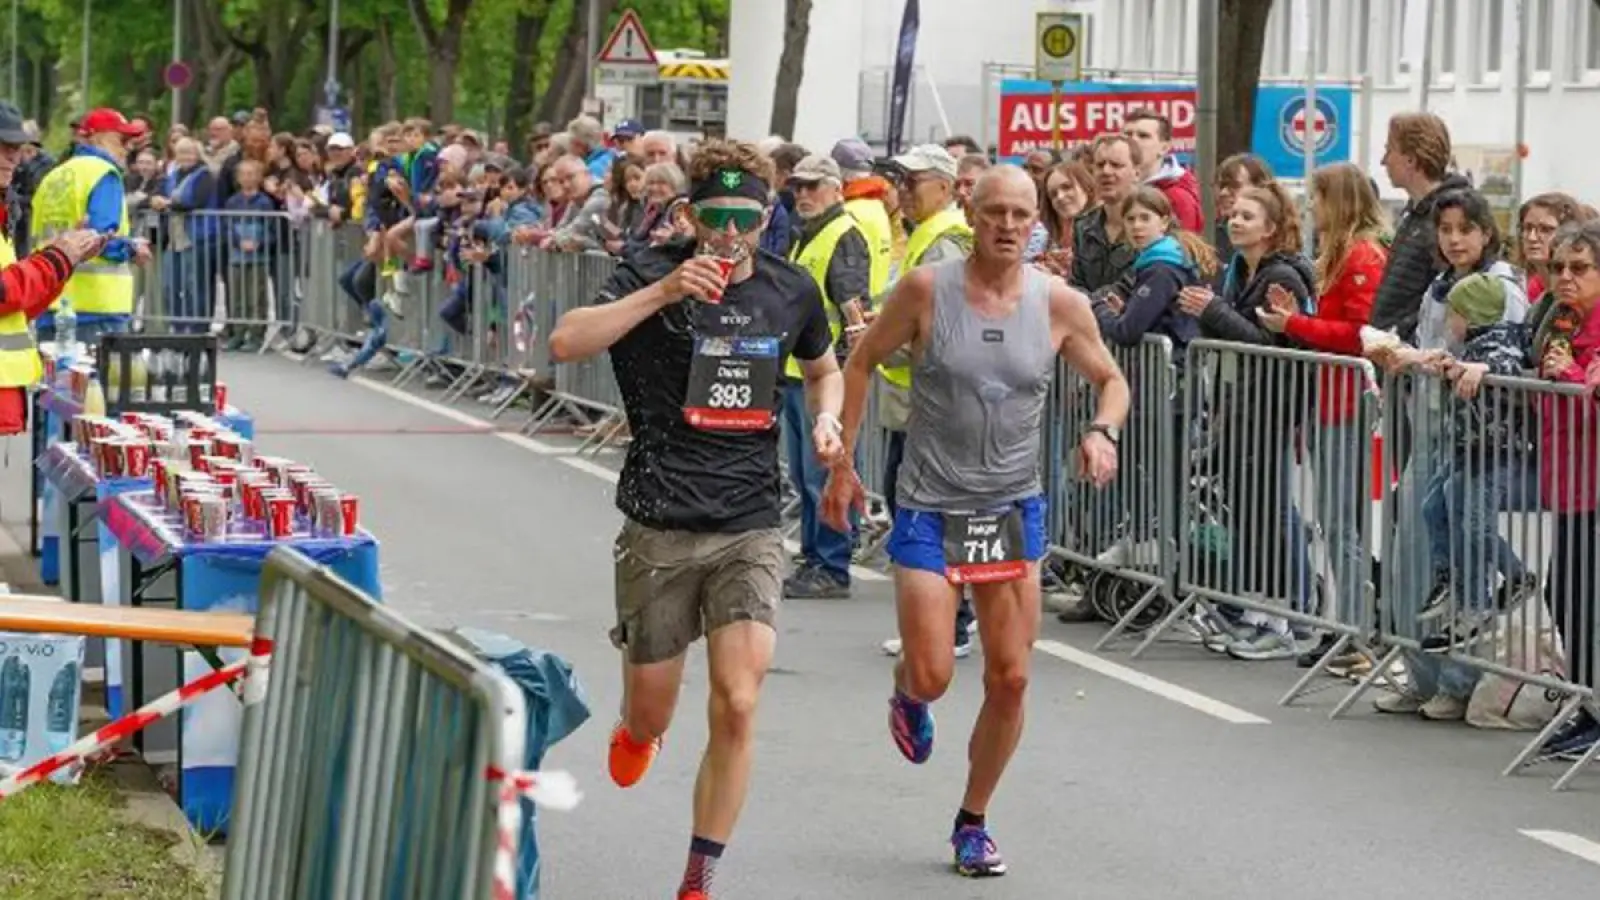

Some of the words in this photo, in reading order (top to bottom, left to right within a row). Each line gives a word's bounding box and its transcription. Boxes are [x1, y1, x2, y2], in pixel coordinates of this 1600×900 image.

[1051, 31, 1066, 51] H
[1009, 102, 1077, 132] AUS
[708, 383, 752, 408] 393
[964, 539, 1005, 563] 714
